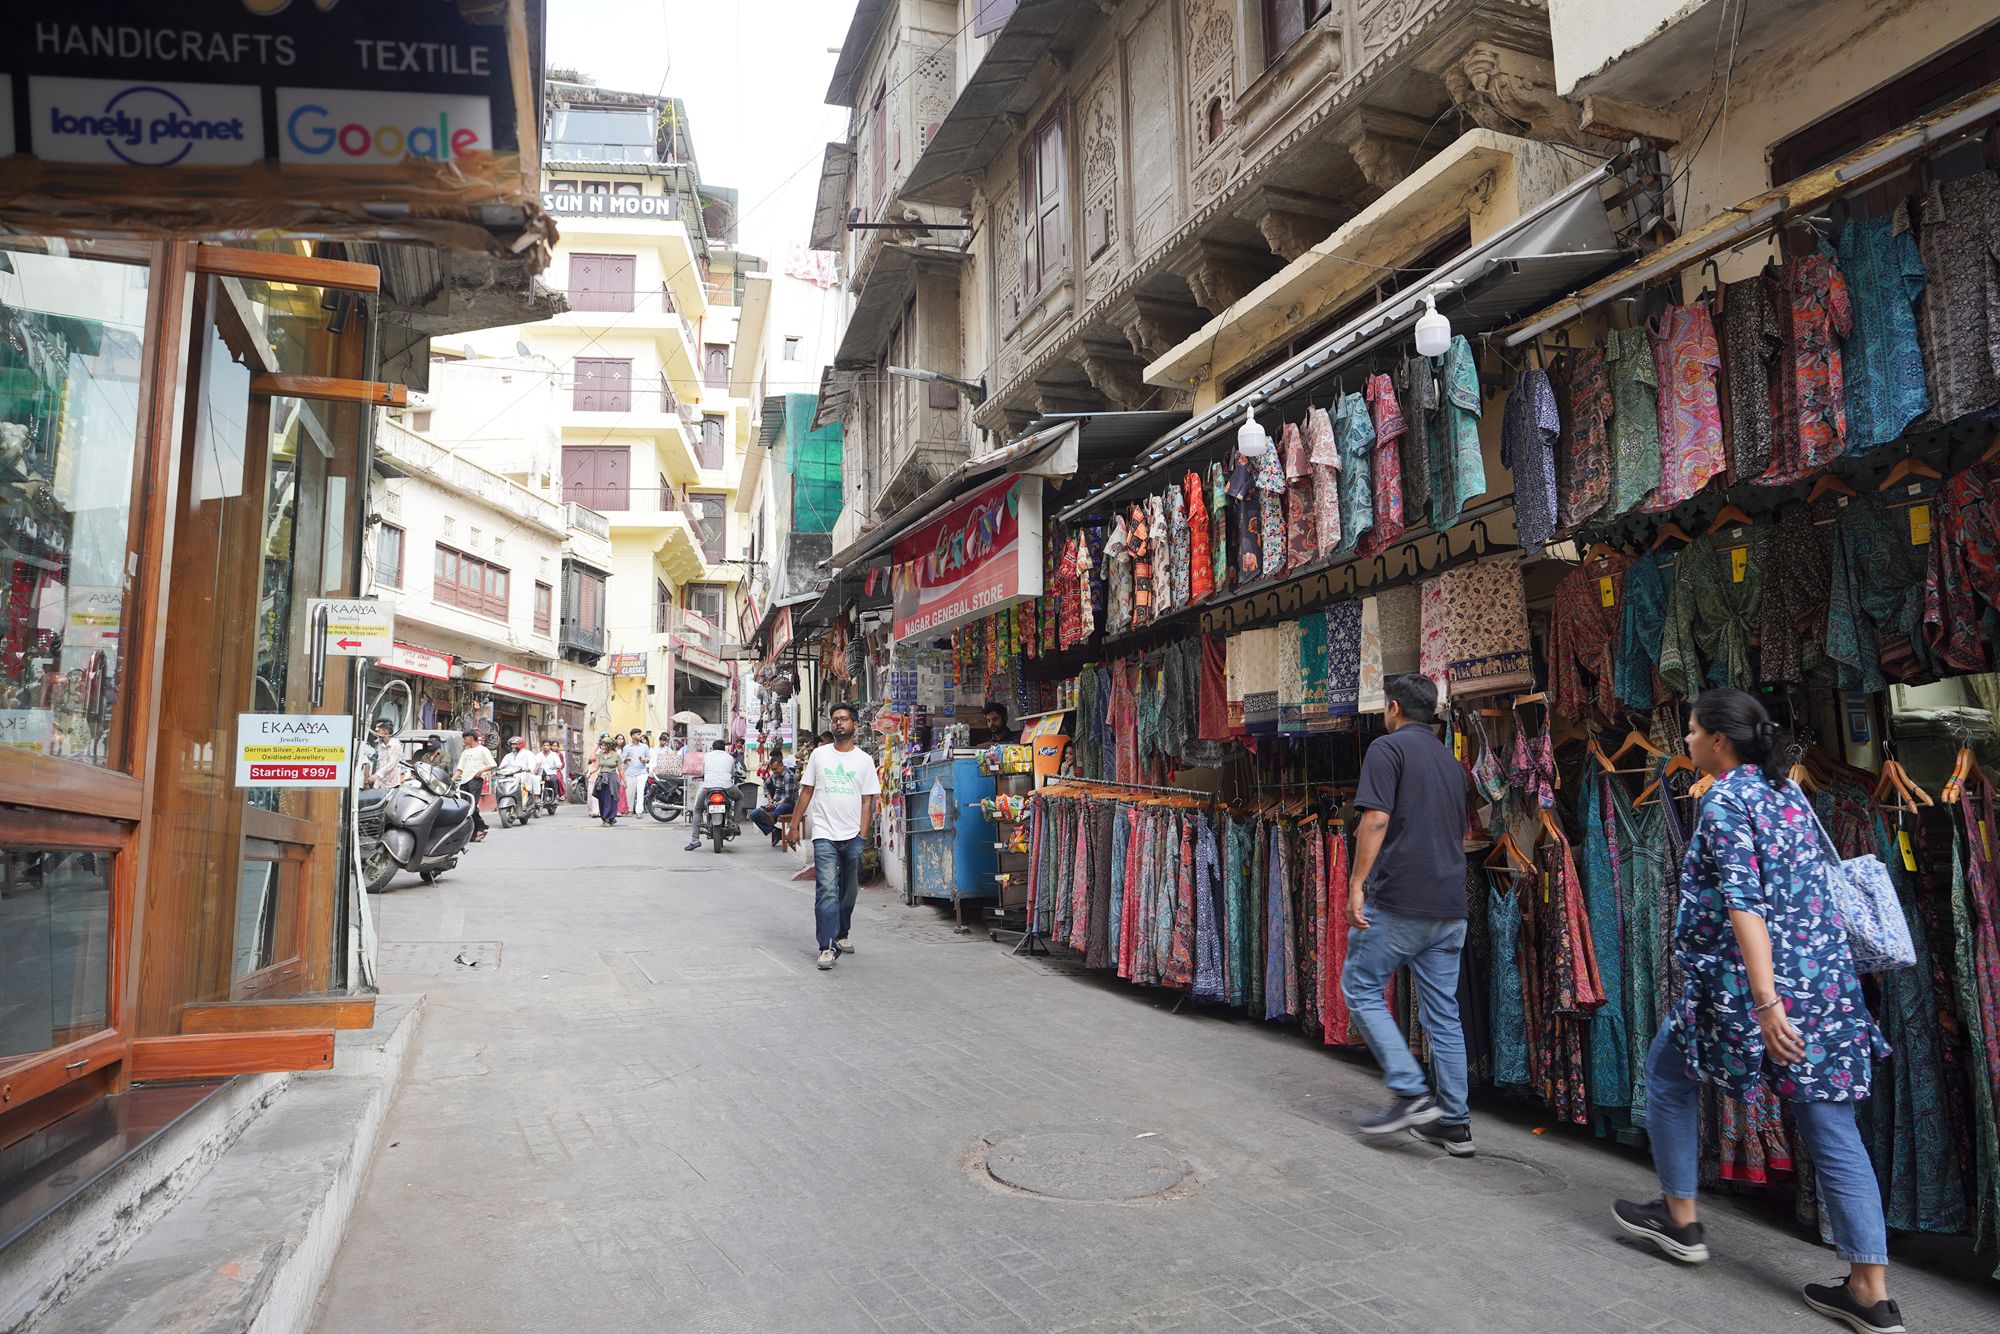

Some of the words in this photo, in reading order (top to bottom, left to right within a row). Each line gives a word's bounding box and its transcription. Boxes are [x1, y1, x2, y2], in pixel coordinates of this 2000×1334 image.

[36, 23, 296, 66] HANDICRAFTS
[355, 40, 491, 76] TEXTILE
[51, 107, 142, 145] lonely
[149, 112, 244, 147] planet
[287, 104, 480, 160] Google
[543, 194, 583, 212] SUN
[589, 196, 604, 213] N
[610, 196, 670, 216] MOON
[904, 614, 931, 637] NAGAR
[931, 600, 971, 625] GENERAL
[972, 583, 1004, 610] STORE
[621, 666, 646, 674] CLASSES
[262, 721, 329, 734] EKAAYA
[279, 736, 309, 744] Jewellery
[251, 767, 299, 778] Starting
[302, 767, 335, 778] ₹99/-
